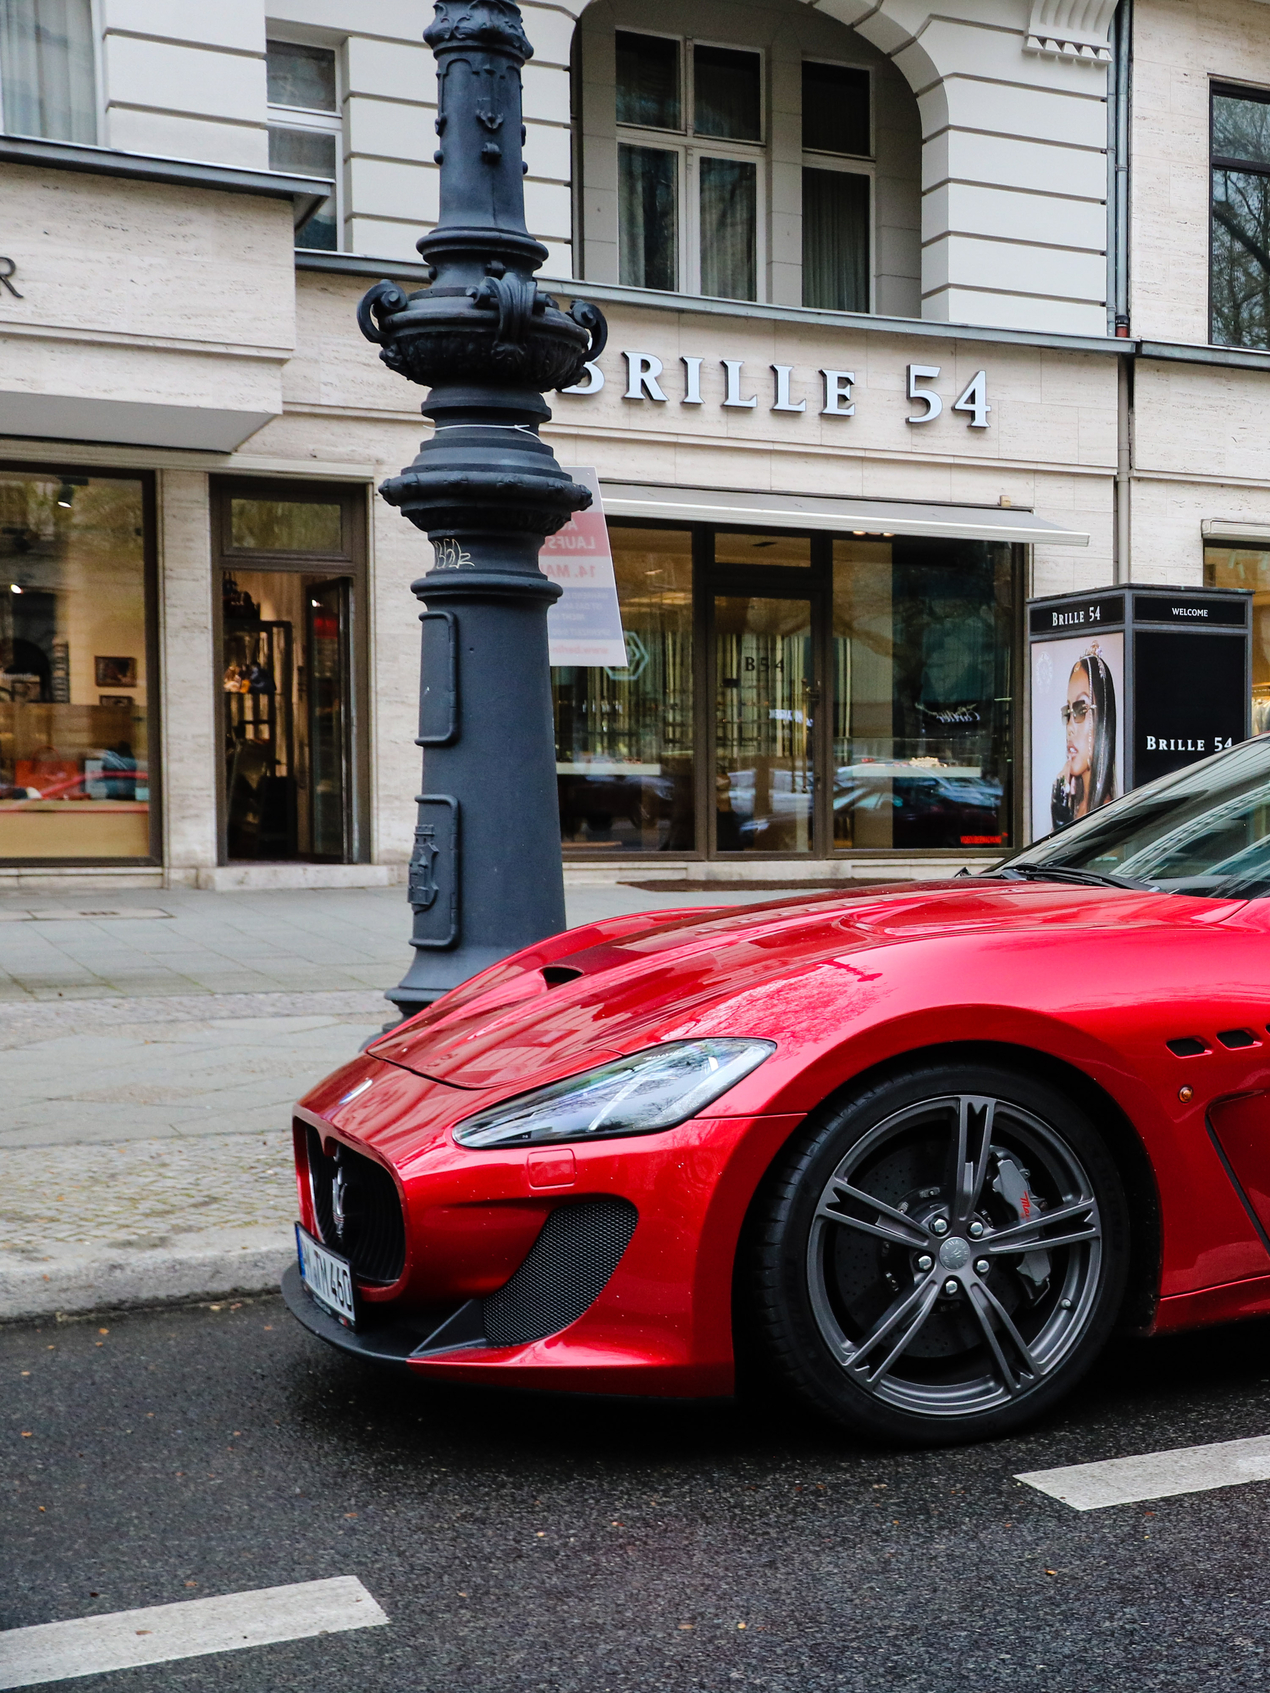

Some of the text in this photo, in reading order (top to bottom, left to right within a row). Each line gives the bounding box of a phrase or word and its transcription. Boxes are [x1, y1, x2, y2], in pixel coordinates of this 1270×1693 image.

[905, 364, 992, 428] 54
[1052, 606, 1101, 627] BRILLE 54
[1171, 607, 1209, 618] WELCOME
[1146, 736, 1233, 752] BRILLE 54
